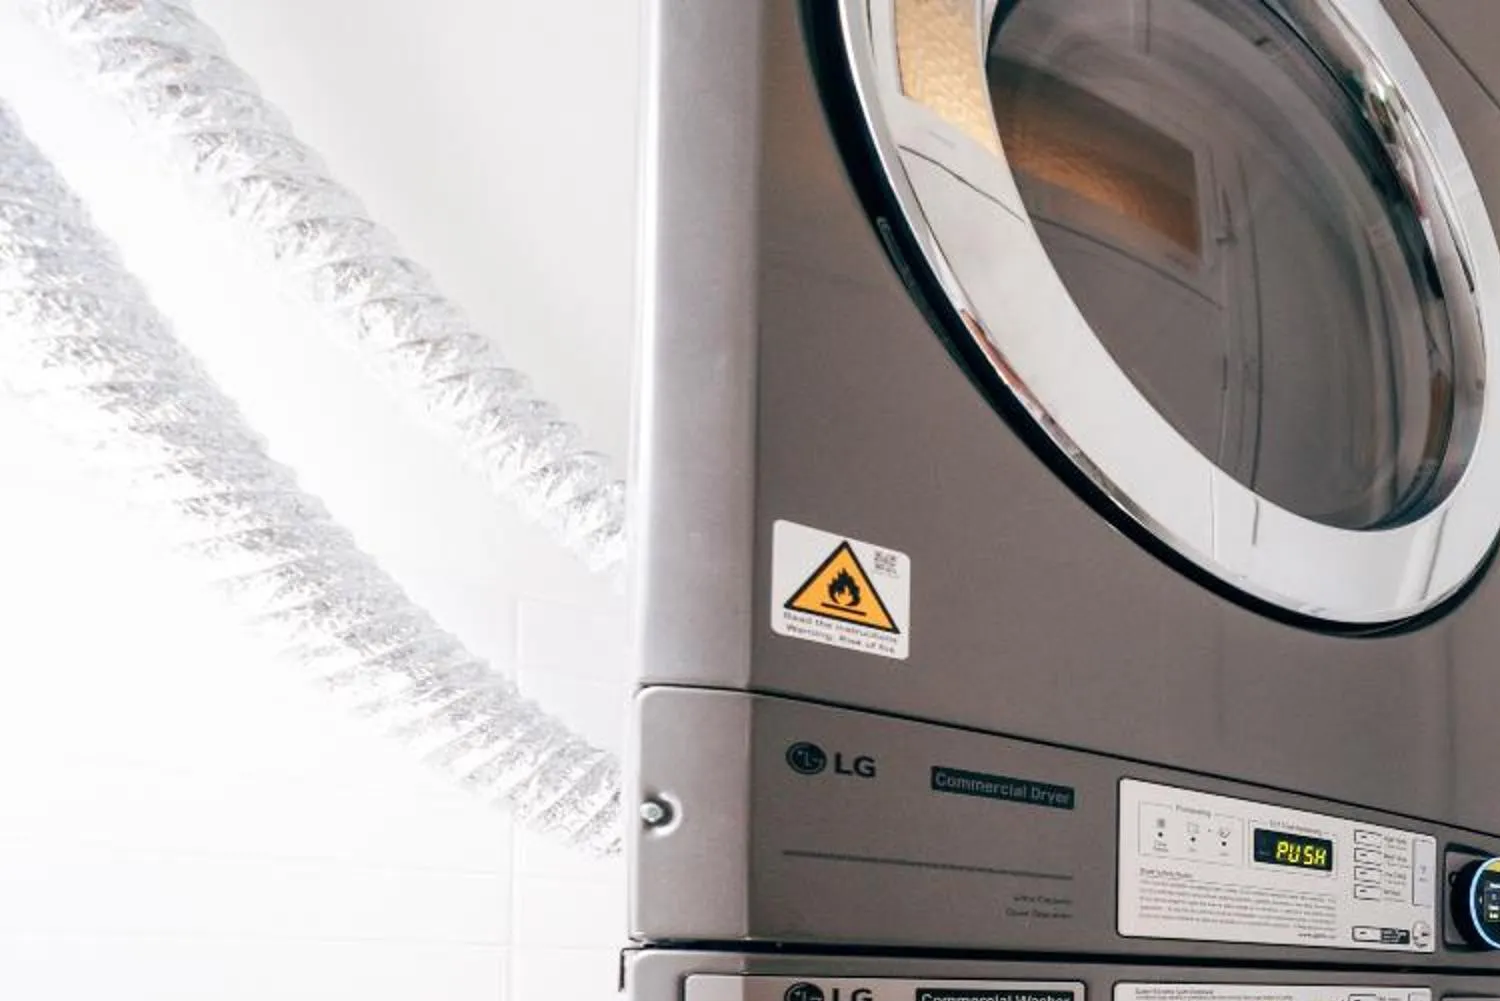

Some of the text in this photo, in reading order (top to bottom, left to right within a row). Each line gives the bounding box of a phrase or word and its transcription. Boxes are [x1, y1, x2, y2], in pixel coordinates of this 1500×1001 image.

[834, 752, 876, 778] LG
[935, 772, 1070, 806] Commercial Dryer
[1275, 841, 1327, 866] PUSH
